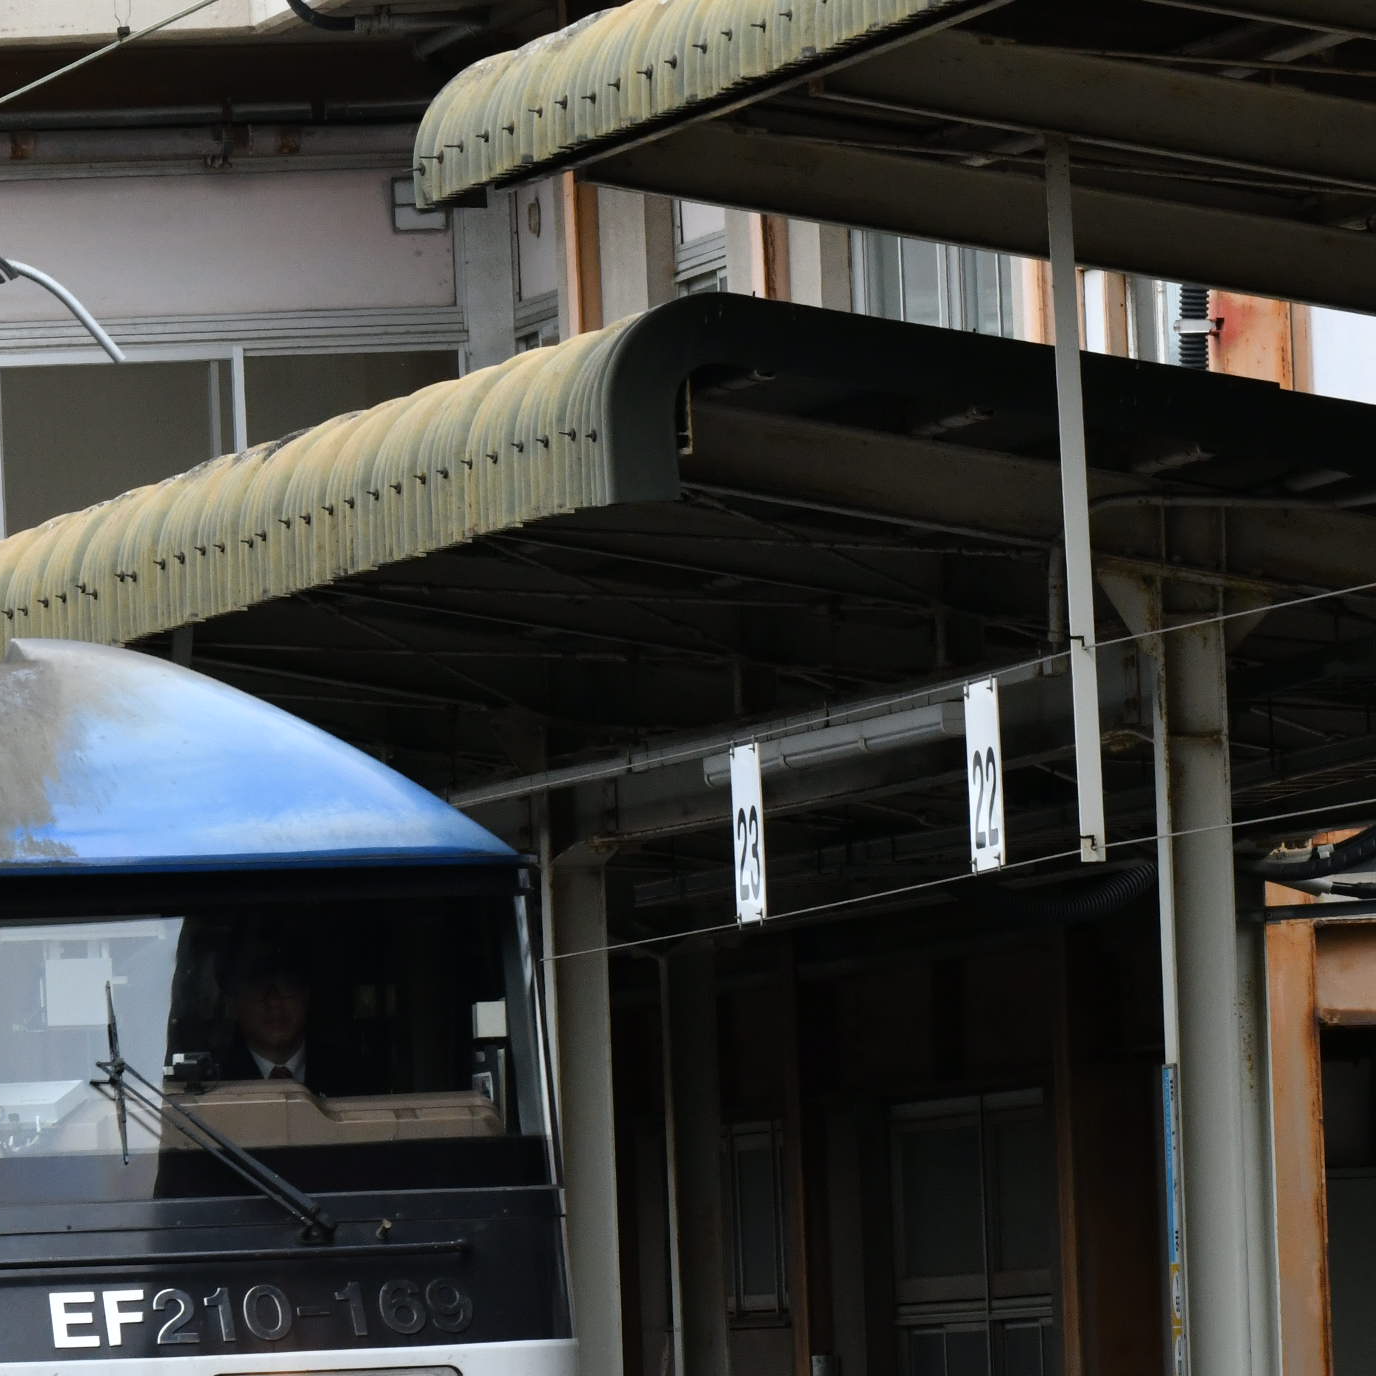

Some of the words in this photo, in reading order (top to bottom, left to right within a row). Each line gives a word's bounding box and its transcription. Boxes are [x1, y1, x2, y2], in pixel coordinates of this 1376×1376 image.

[971, 745, 1000, 850] 22
[737, 804, 761, 902] 23
[48, 1277, 475, 1349] EF210-169
